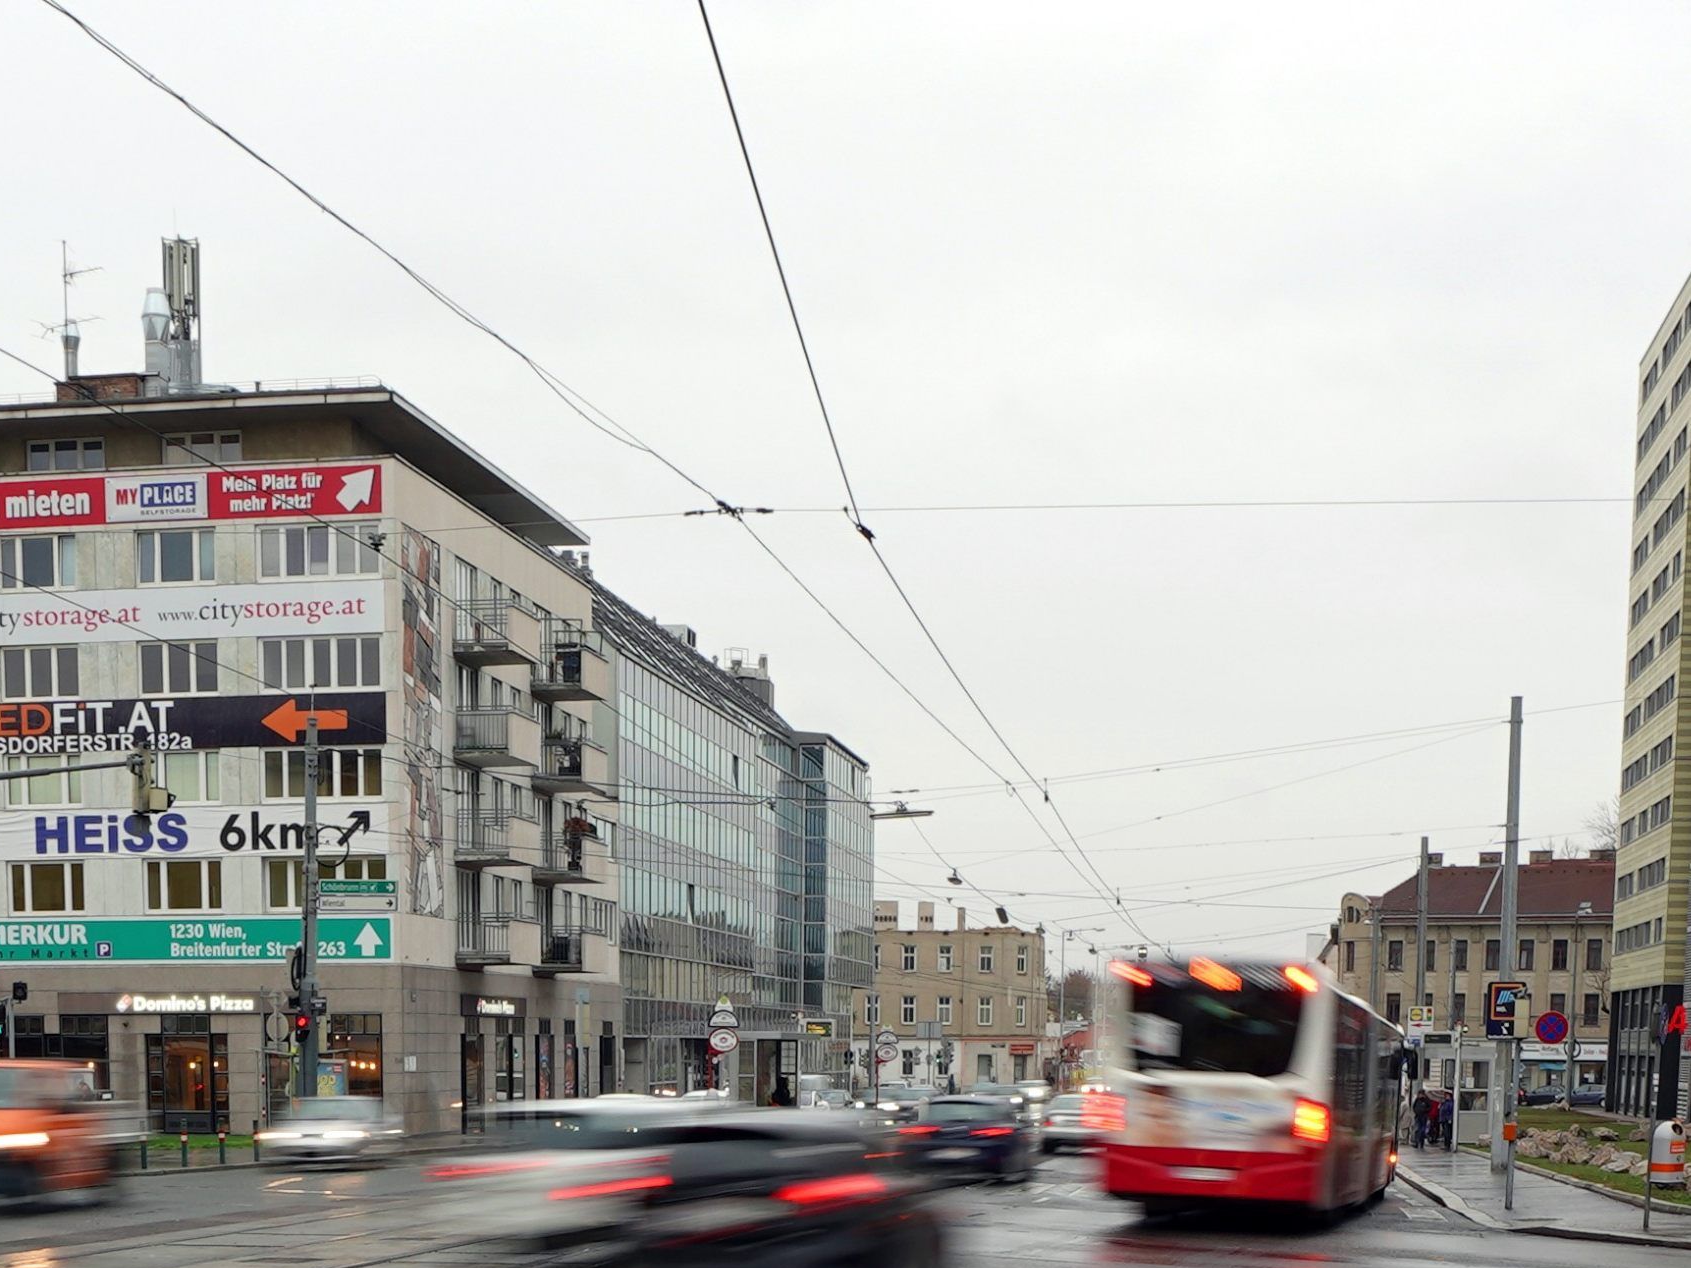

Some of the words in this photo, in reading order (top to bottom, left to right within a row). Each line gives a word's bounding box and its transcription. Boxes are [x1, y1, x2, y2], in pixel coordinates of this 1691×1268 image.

[222, 475, 256, 493] Mein
[261, 471, 297, 490] Platz
[301, 472, 322, 489] für
[116, 488, 138, 505] MY
[142, 483, 195, 505] PLACE
[6, 489, 91, 519] mieten
[140, 507, 196, 516] SELFSTORAGE
[230, 497, 267, 512] mehr
[157, 596, 367, 628] www.citystorage.at
[146, 732, 193, 751] 182a
[219, 811, 319, 851] 6km
[169, 923, 204, 939] 1230
[208, 924, 247, 940] Wien,
[31, 948, 88, 958] Markt
[170, 942, 262, 957] Breitenfurter
[317, 941, 346, 957] 263
[133, 995, 206, 1011] Domino's
[210, 995, 254, 1011] Pizza
